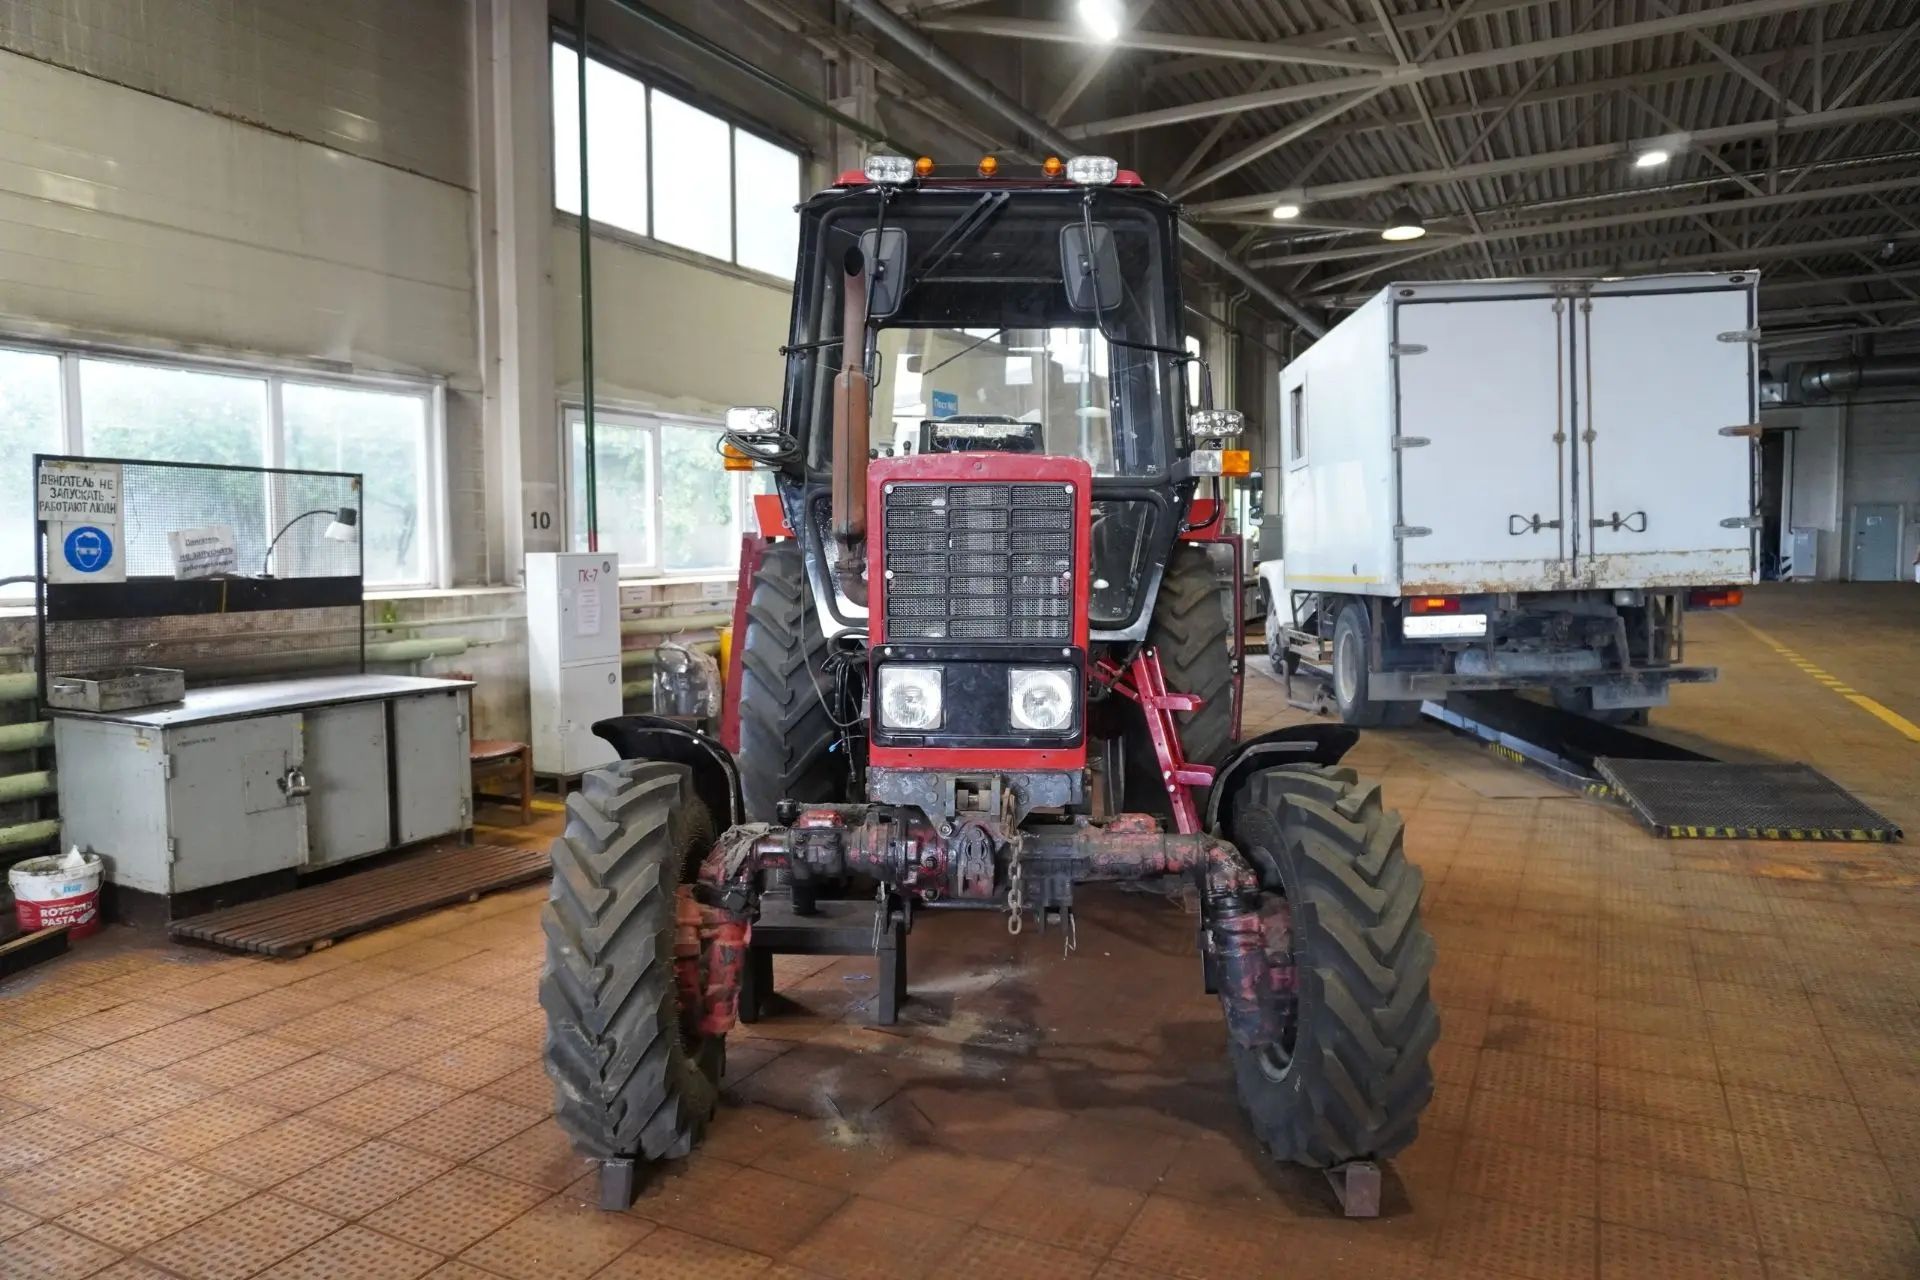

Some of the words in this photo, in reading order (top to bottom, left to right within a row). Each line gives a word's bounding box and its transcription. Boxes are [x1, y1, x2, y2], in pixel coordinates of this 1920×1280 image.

[40, 474, 94, 488] ДВИГАТЕЛЬ
[99, 479, 113, 490] НЕ
[49, 487, 105, 501] ЗАПУСКАТЬ
[39, 501, 88, 513] РАБОТАЮТ
[89, 502, 117, 514] ЛЮДИ
[530, 511, 551, 530] 10
[41, 916, 76, 927] PASTA
